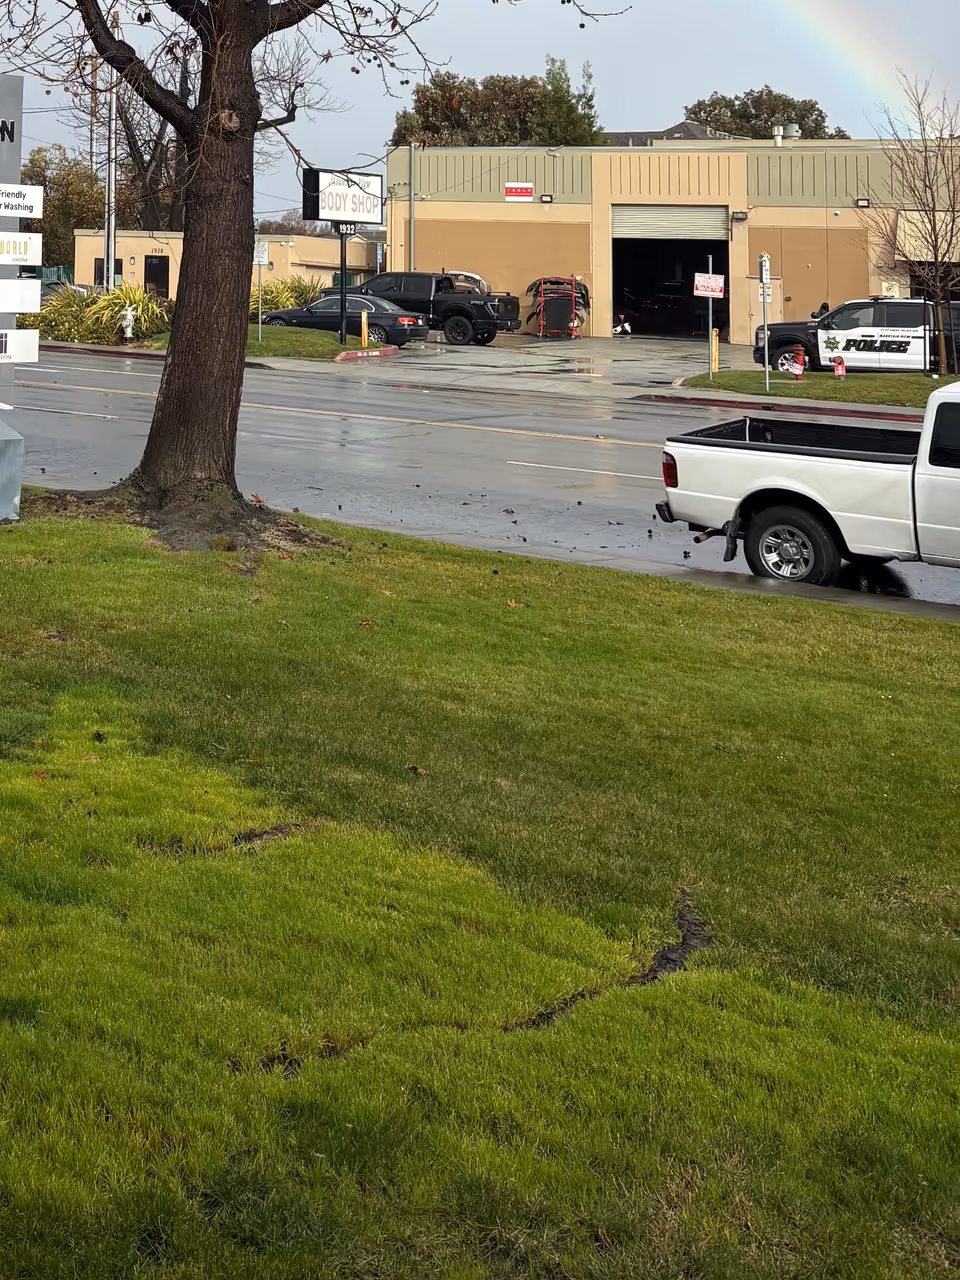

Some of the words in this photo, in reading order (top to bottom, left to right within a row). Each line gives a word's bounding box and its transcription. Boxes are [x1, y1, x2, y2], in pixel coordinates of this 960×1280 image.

[3, 201, 34, 214] Washing
[320, 191, 348, 211] BODY
[351, 193, 379, 215] SHOP
[339, 223, 355, 234] 1932
[842, 339, 911, 353] POLICE
